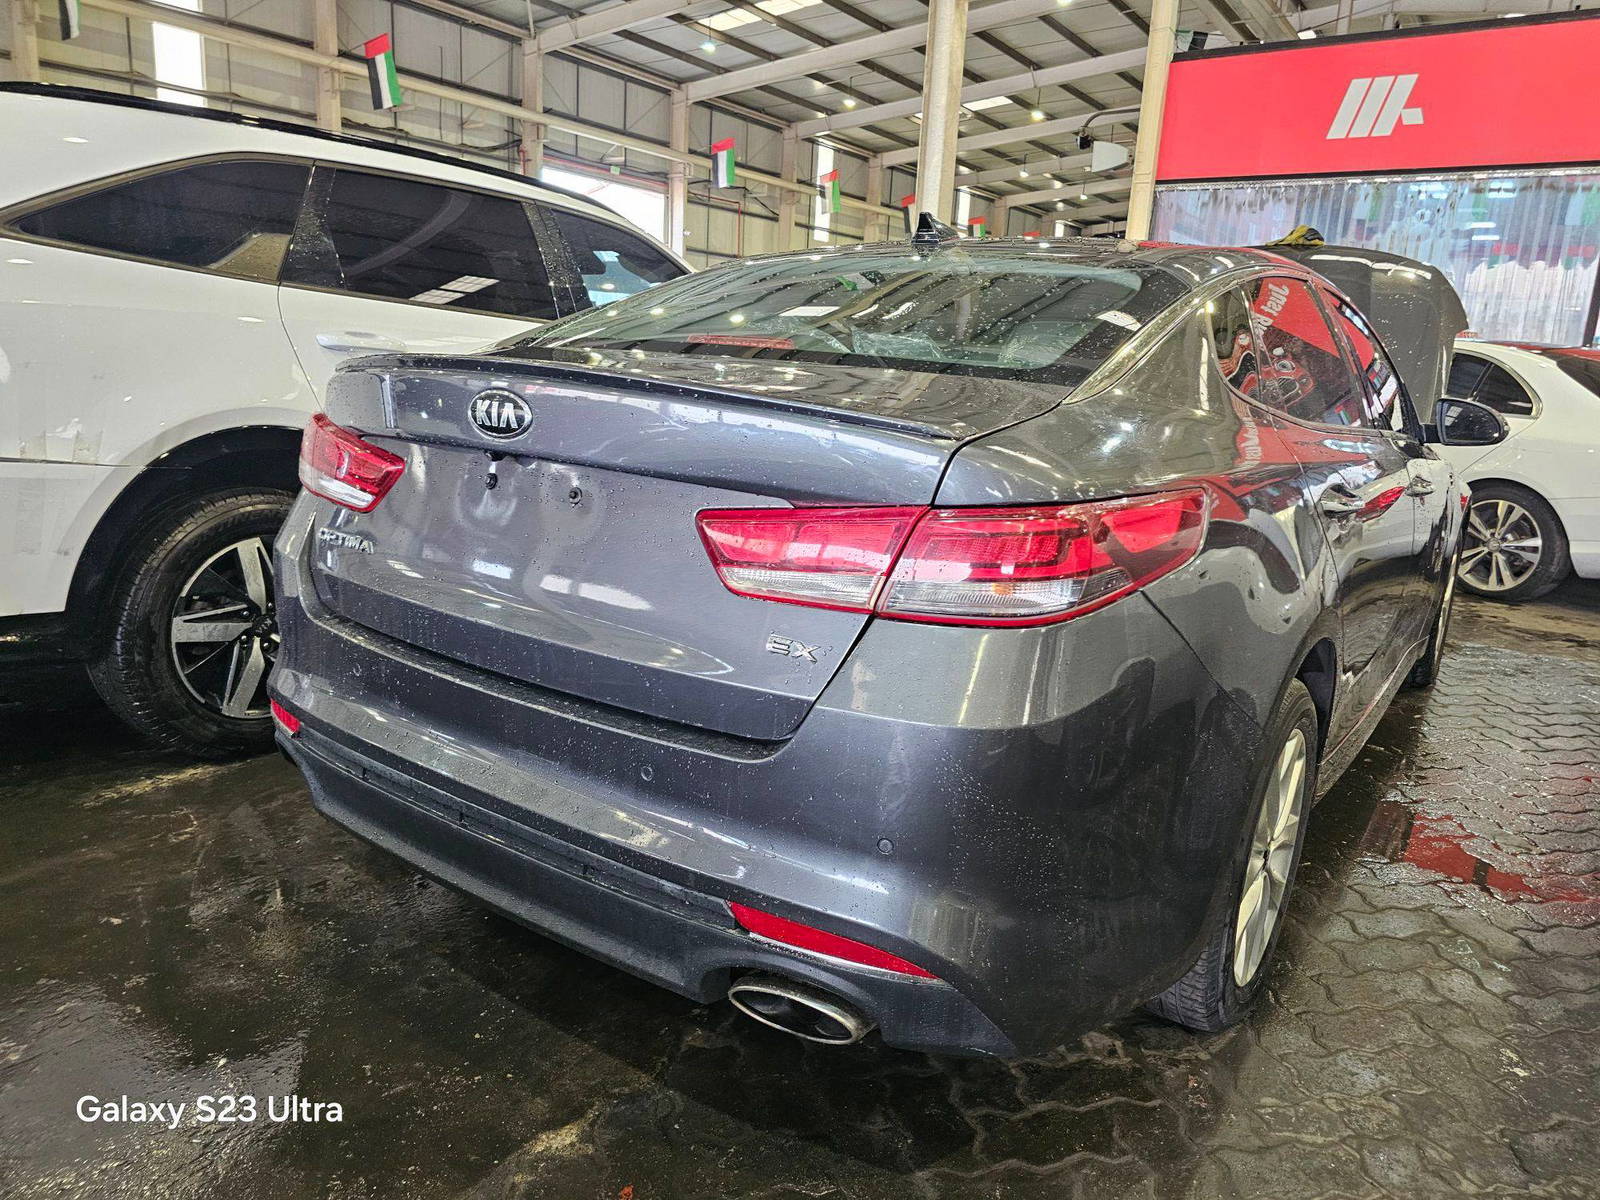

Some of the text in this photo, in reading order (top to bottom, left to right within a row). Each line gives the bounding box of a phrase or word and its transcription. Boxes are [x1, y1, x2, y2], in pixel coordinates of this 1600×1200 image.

[475, 399, 519, 429] KIA
[318, 527, 374, 554] OPTIMA
[765, 634, 821, 664] EX
